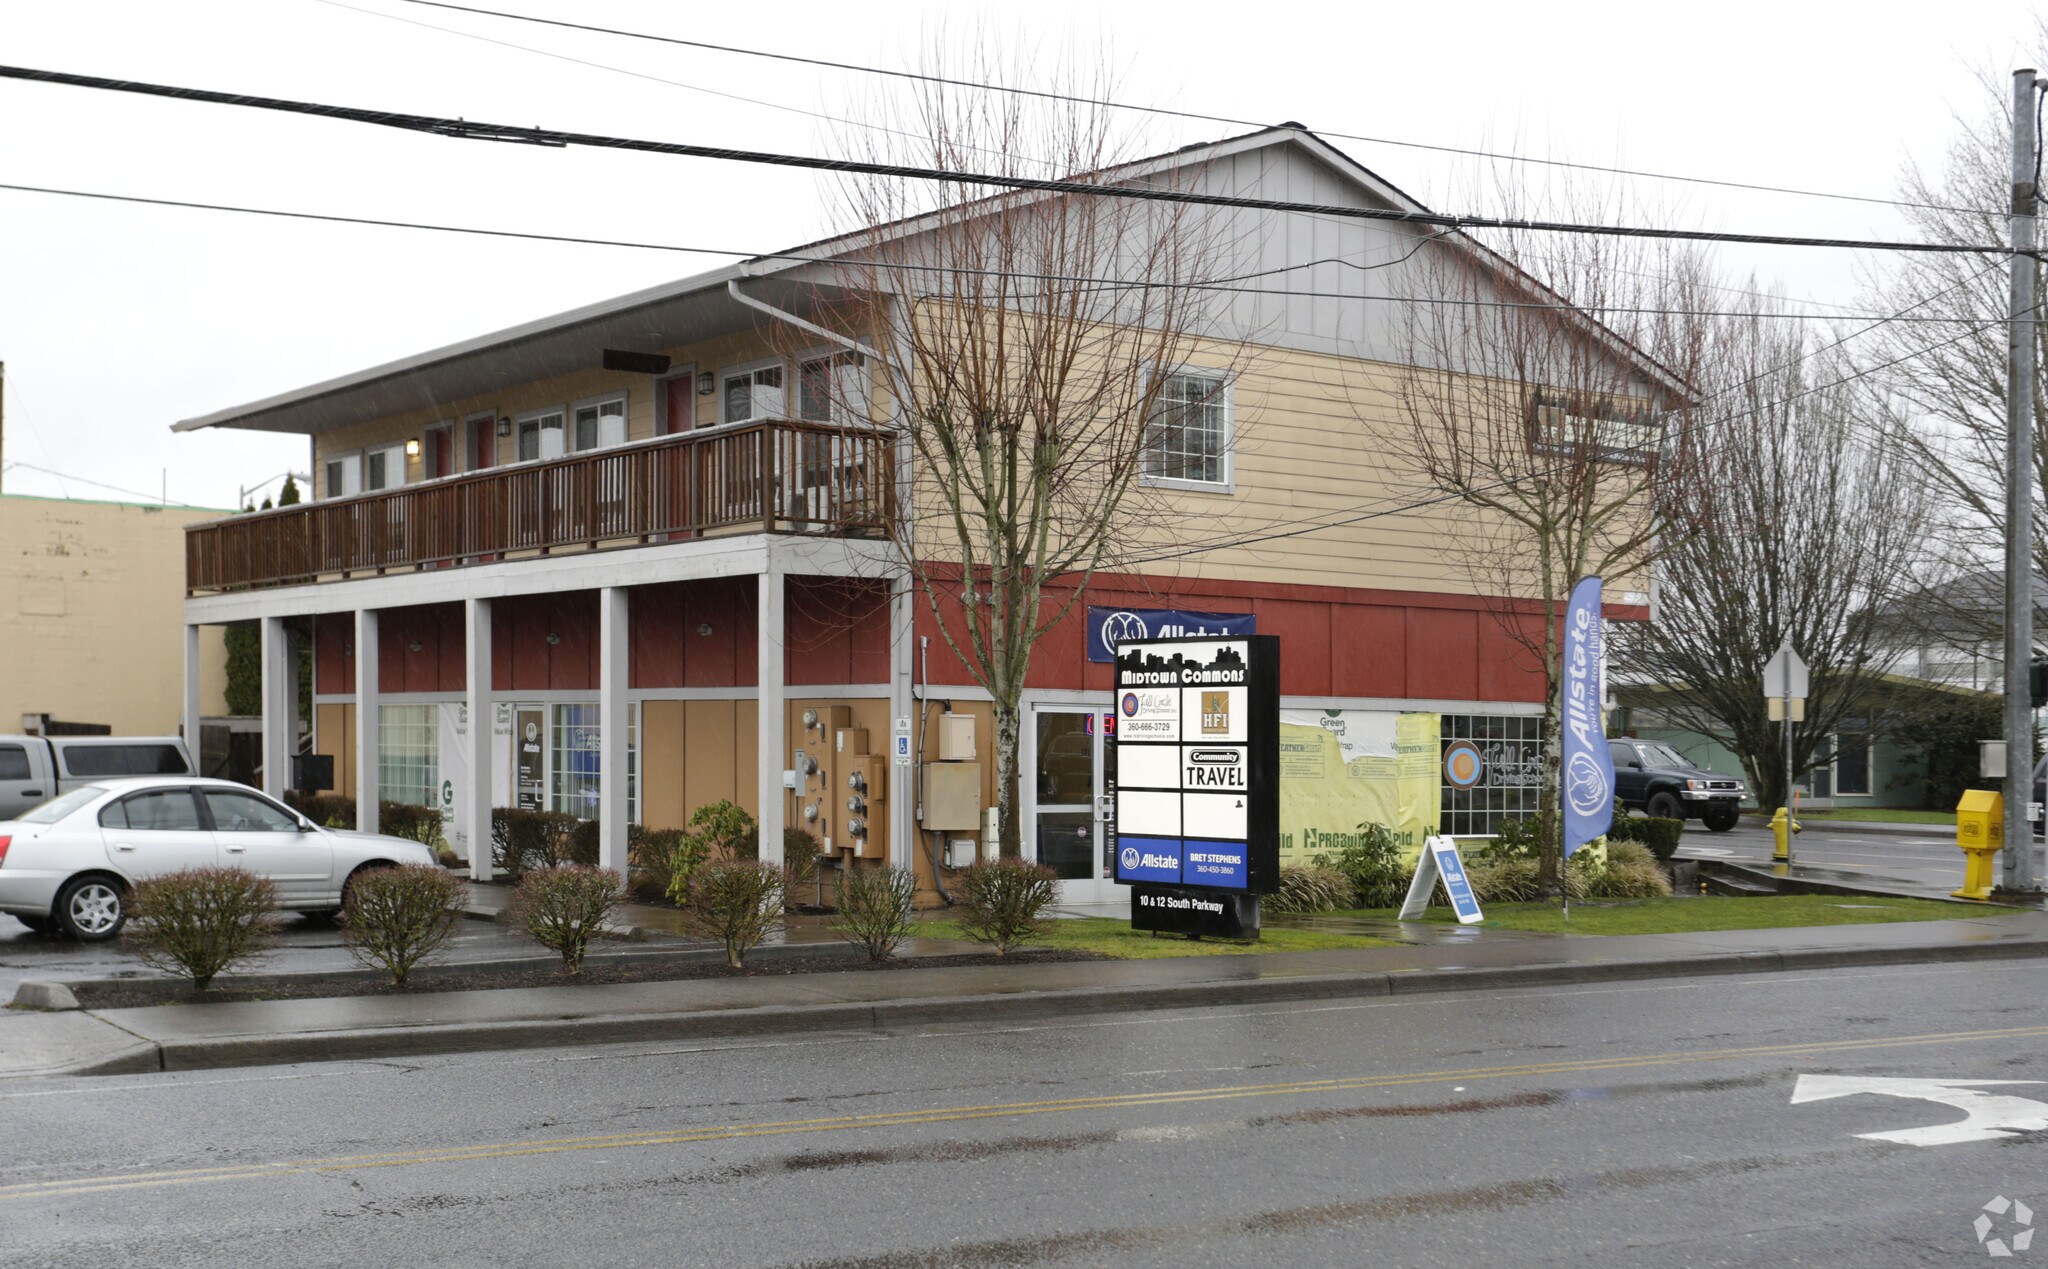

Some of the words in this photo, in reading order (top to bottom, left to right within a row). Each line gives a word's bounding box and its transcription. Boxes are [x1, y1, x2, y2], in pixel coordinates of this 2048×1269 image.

[1588, 652, 1600, 682] good
[1568, 608, 1594, 751] Allstate
[1587, 685, 1597, 697] in
[1203, 713, 1228, 727] HFI
[1320, 717, 1345, 727] Green
[1192, 752, 1238, 763] Community
[1187, 767, 1244, 787] TRAVEL
[1140, 853, 1178, 869] Allstate
[1190, 853, 1207, 863] BRET
[1208, 854, 1241, 865] STEPHENS
[1140, 895, 1148, 906] 10
[1150, 897, 1155, 906] &
[1156, 896, 1166, 907] 12
[1167, 897, 1190, 909] South
[1191, 899, 1224, 914] Parkway
